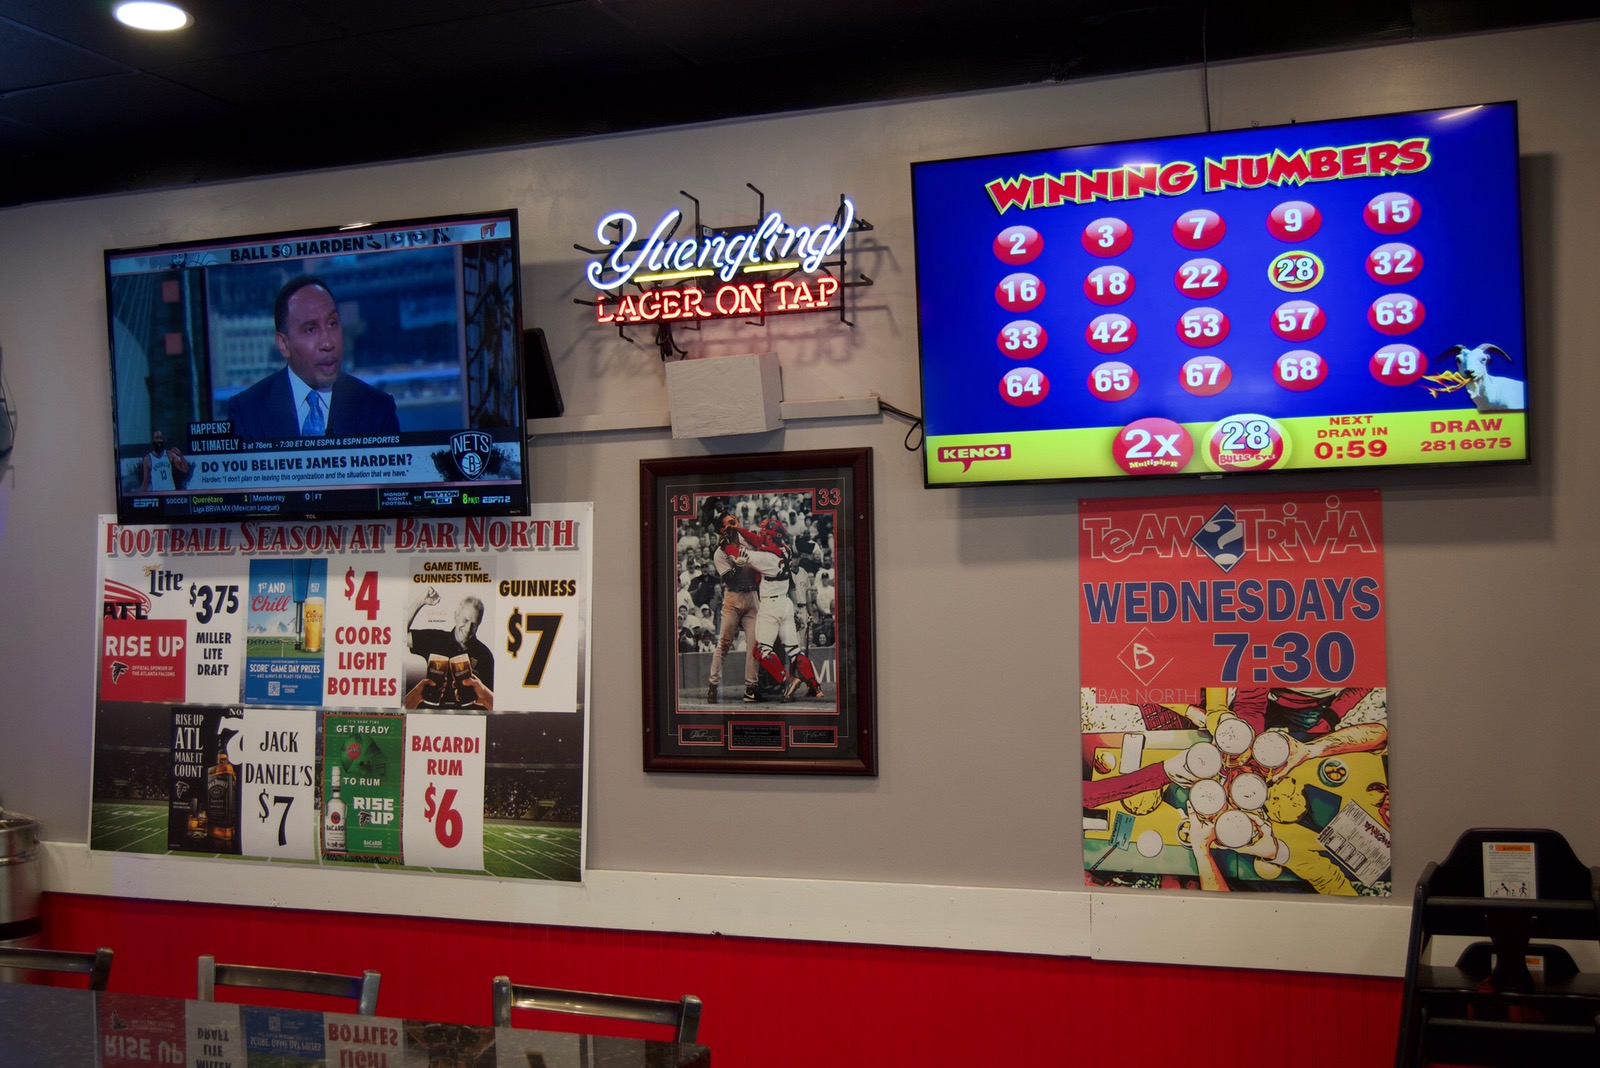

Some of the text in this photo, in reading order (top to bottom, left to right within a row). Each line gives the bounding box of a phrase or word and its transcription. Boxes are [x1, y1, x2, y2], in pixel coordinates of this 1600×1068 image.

[986, 138, 1432, 214] WINNING NUMBERS
[1009, 200, 1411, 255] 2 3 7 9 15
[230, 248, 268, 262] BALL
[296, 237, 364, 256] HARDEN
[587, 199, 855, 289] Yuengling
[1002, 250, 1413, 303] 16 18 22 28 32
[597, 278, 839, 322] LAGER ON TAP
[1004, 300, 1414, 350] 33 42 53 57 63
[1006, 351, 1417, 397] 64 65 67 68 79
[190, 422, 231, 435] HAPPENS?
[1329, 416, 1373, 426] NEXT
[1430, 418, 1502, 434] DRAW
[362, 436, 400, 444] DEPORTES
[1221, 420, 1271, 450] 28
[1317, 427, 1388, 438] DRAW IN
[192, 439, 239, 452] ULTIMATELY
[454, 434, 489, 454] NETS
[1314, 440, 1387, 460] 0:59
[1420, 437, 1512, 452] 2816675
[942, 446, 1006, 460] KENO!
[202, 453, 412, 473] DO YOU BELIEVE JAMES HARDEN?
[160, 470, 167, 480] 13
[241, 475, 252, 483] plan
[292, 472, 324, 481] organization
[133, 499, 159, 507] ESPN
[192, 496, 224, 504] Querétaro
[253, 494, 285, 503] Monterrey
[670, 488, 842, 512] 13 33
[258, 504, 280, 512] League)
[424, 561, 482, 571] GAME TIME.
[149, 570, 184, 597] Lite
[413, 573, 492, 583] GUINNESS TIME.
[268, 582, 286, 593] AND
[344, 566, 380, 620] $4
[499, 580, 576, 597] GUINNESS
[252, 595, 291, 612] Chill
[1083, 576, 1381, 624] WEDNESDAYS
[104, 601, 148, 620] ATL
[196, 632, 232, 644] MILLER
[335, 626, 391, 645] COORS
[106, 636, 184, 657] RISE UP
[203, 648, 223, 660] LITE
[506, 606, 564, 688] $7
[338, 652, 387, 670] LIGHT
[1133, 642, 1155, 670] B
[1212, 631, 1356, 683] 7:30
[197, 664, 229, 676] DRAFT
[271, 664, 287, 672] GAME
[301, 665, 320, 673] PRIZES
[328, 677, 397, 696] BOTTLES
[1098, 688, 1198, 704] BAR NORTH
[175, 713, 204, 726] RISE UP
[229, 708, 244, 716] No.
[358, 726, 390, 734] READY
[175, 727, 203, 751] ATL
[259, 731, 299, 753] JACK
[412, 736, 480, 754] BACARDI
[174, 752, 203, 764] MAKE IT
[174, 764, 203, 778] COUNT
[245, 763, 313, 787] DANIEL'S
[426, 759, 463, 776] RUM
[360, 778, 380, 786] RUM
[353, 797, 394, 810] RISE
[258, 788, 294, 847] $7
[370, 812, 394, 824] UP
[424, 782, 464, 849] $6
